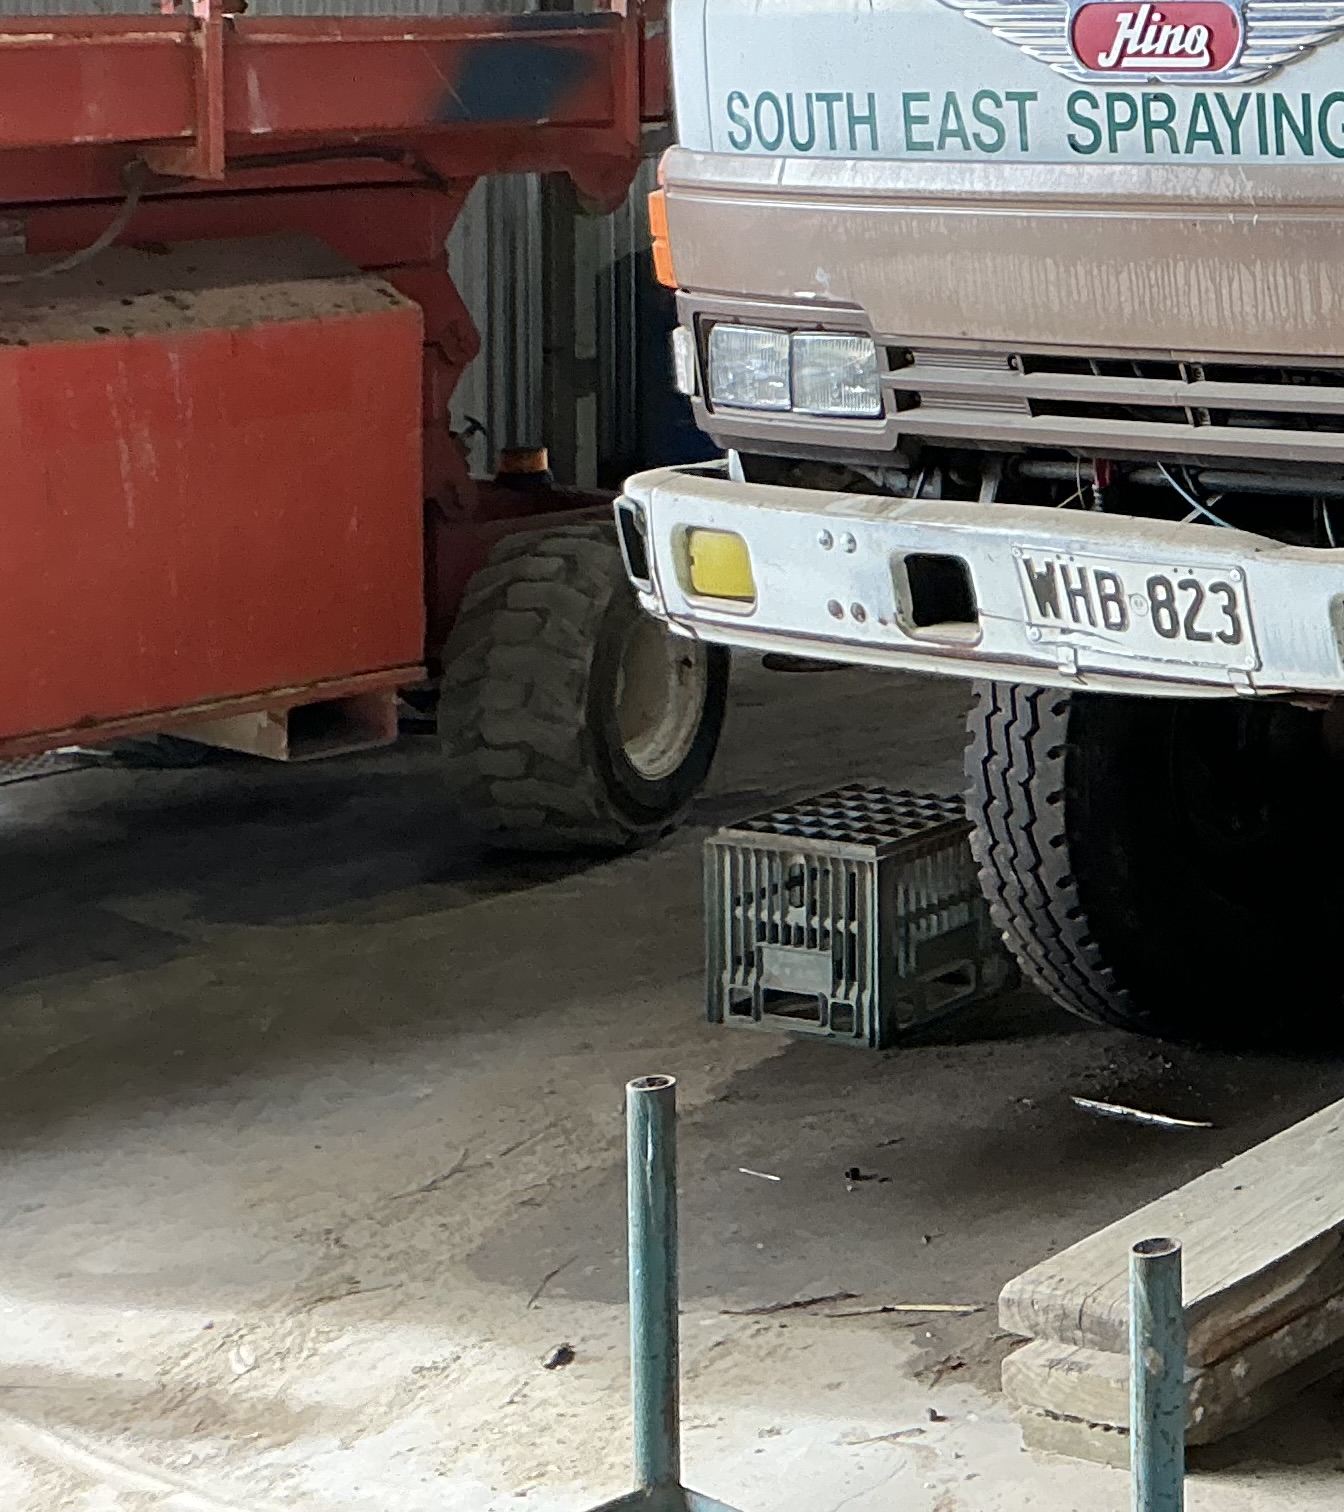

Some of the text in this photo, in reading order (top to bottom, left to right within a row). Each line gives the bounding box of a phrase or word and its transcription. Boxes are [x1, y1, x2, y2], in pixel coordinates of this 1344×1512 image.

[1098, 4, 1210, 67] Hino
[727, 90, 879, 152] SOUTH
[904, 90, 1038, 154] EAST
[1021, 555, 1244, 646] WHB 823
